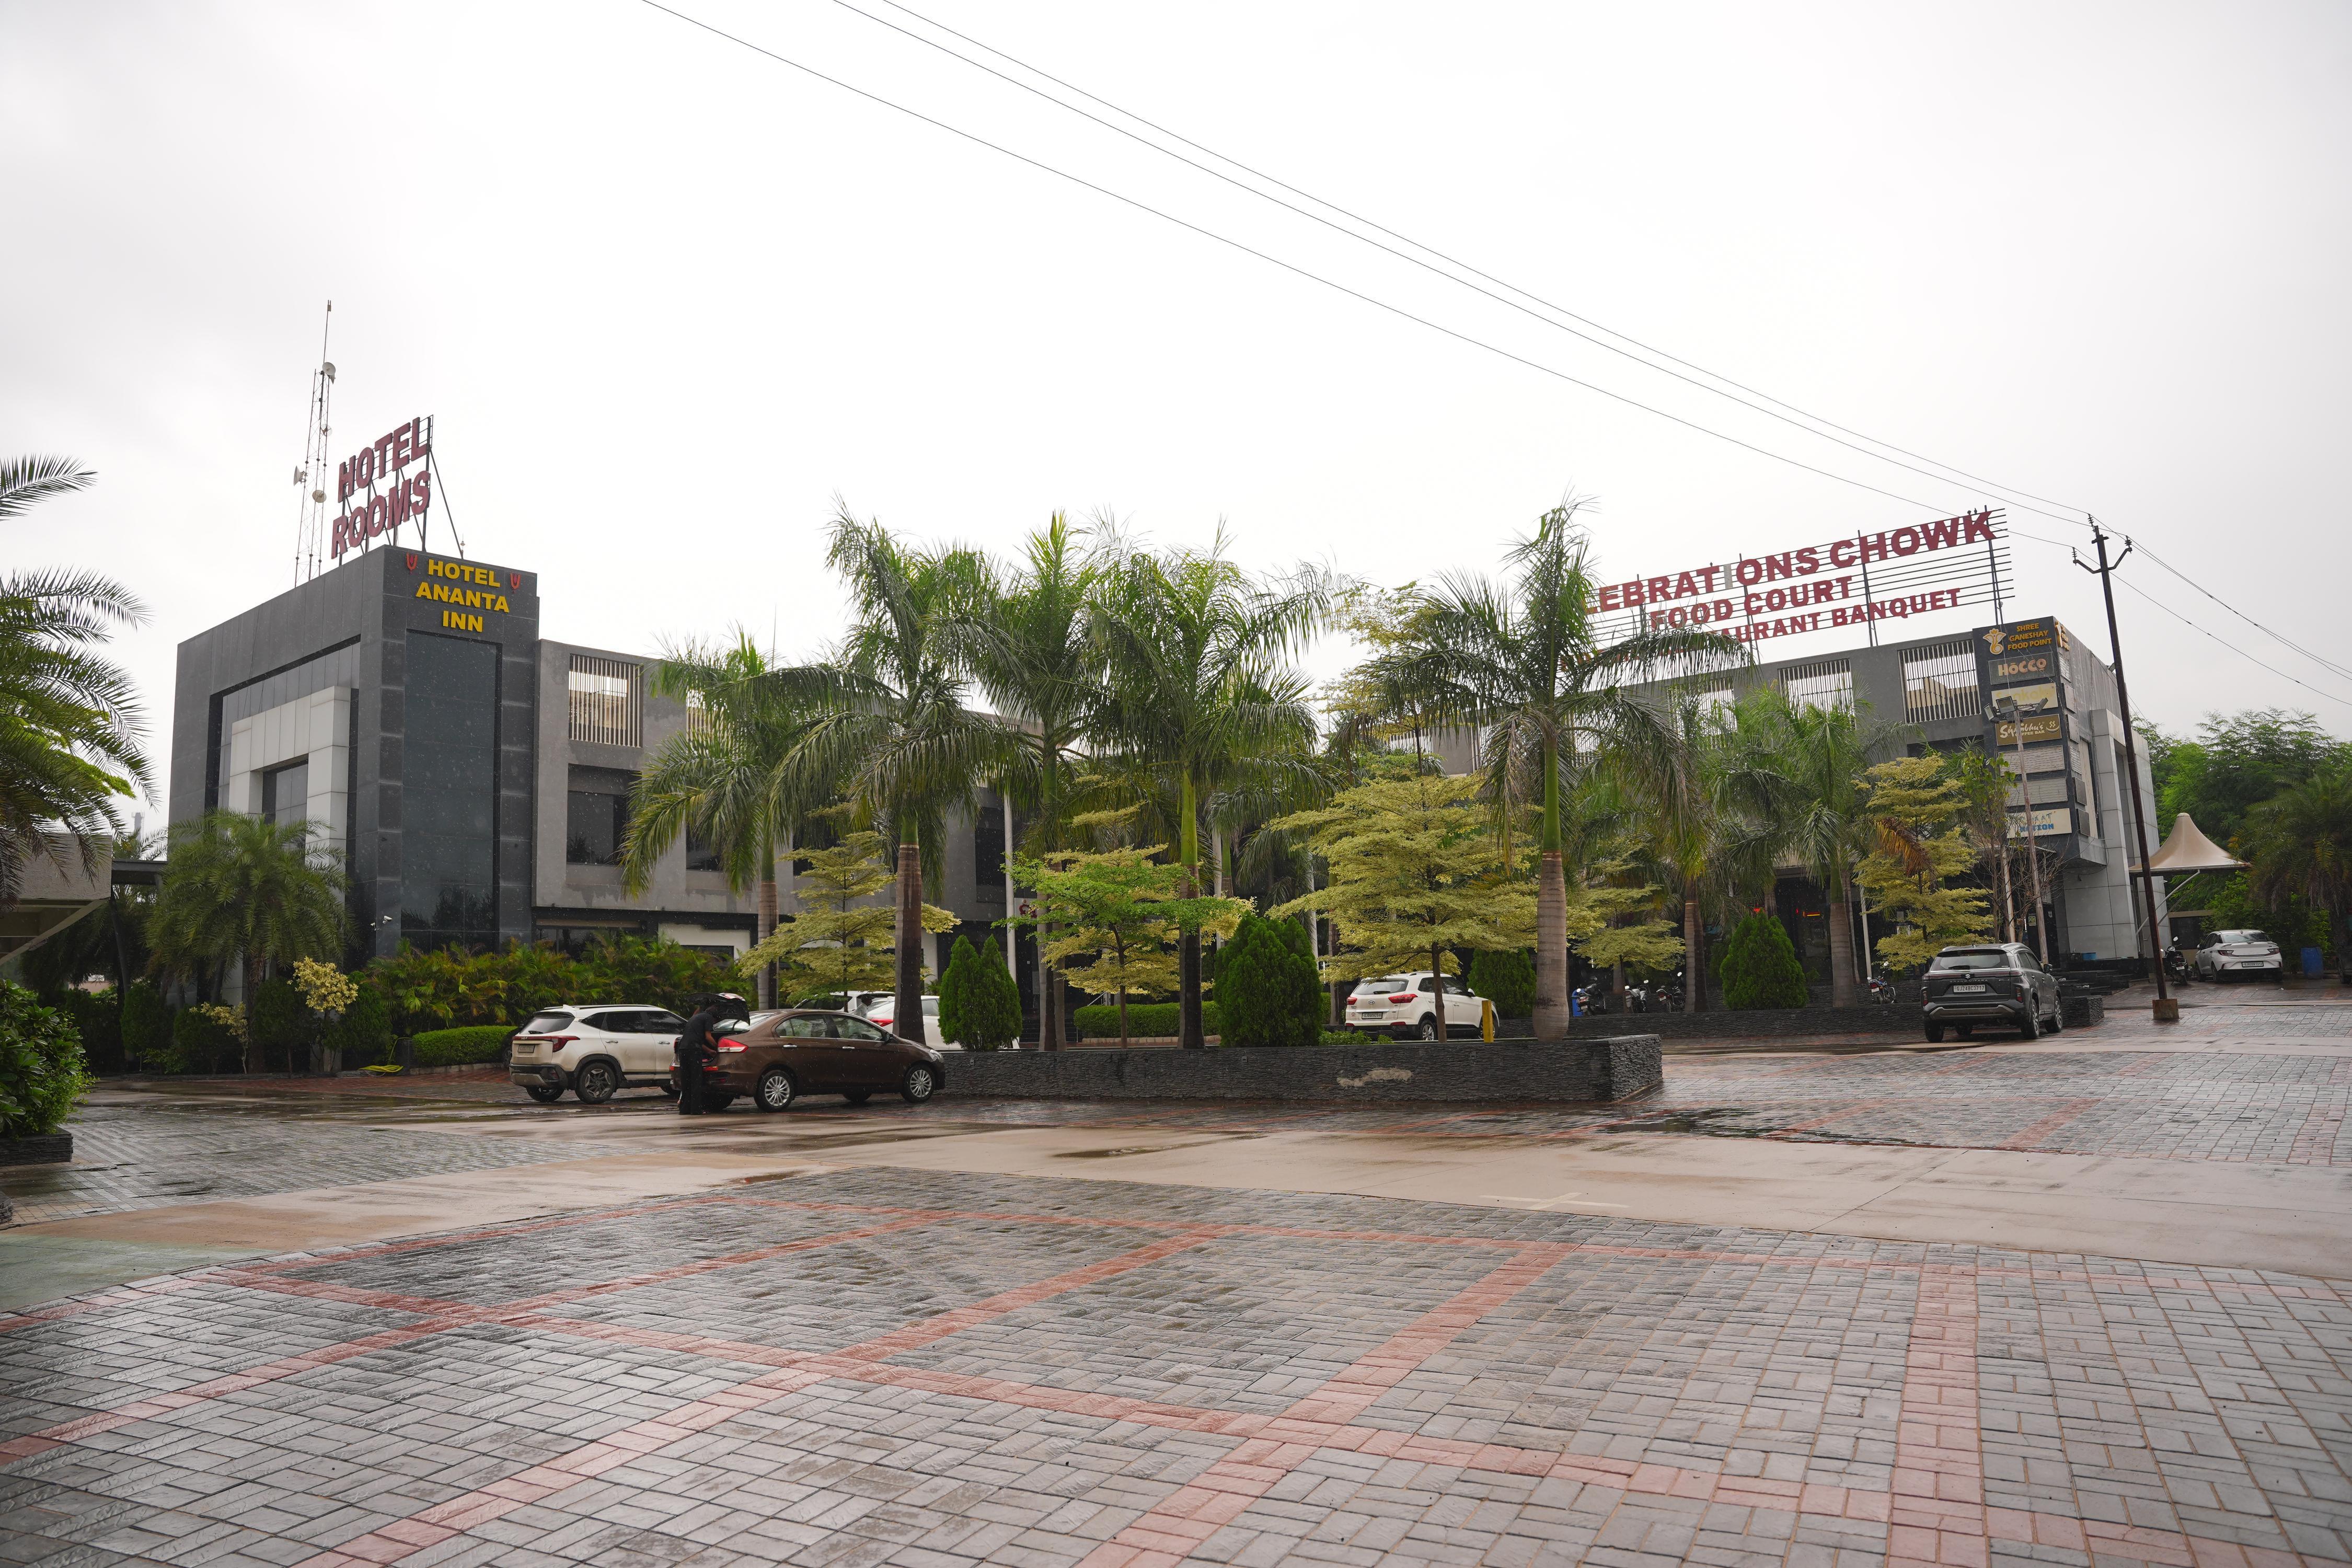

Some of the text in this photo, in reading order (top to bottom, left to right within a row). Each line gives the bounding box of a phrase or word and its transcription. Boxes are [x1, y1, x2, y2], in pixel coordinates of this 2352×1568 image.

[338, 417, 429, 503] HOTEL
[331, 470, 430, 559] ROOMS
[428, 559, 501, 587] HOTEL
[1584, 511, 1996, 615] EBRATIONS CHOWK
[416, 581, 510, 613] ANANTA
[1650, 575, 1853, 632] FOOD COURT
[1831, 587, 1961, 628] BANQUET
[442, 609, 483, 633] INN
[2009, 630, 2049, 642] GANESHAY
[2016, 623, 2039, 632] SHREE
[2008, 638, 2052, 650] FOOD POINT
